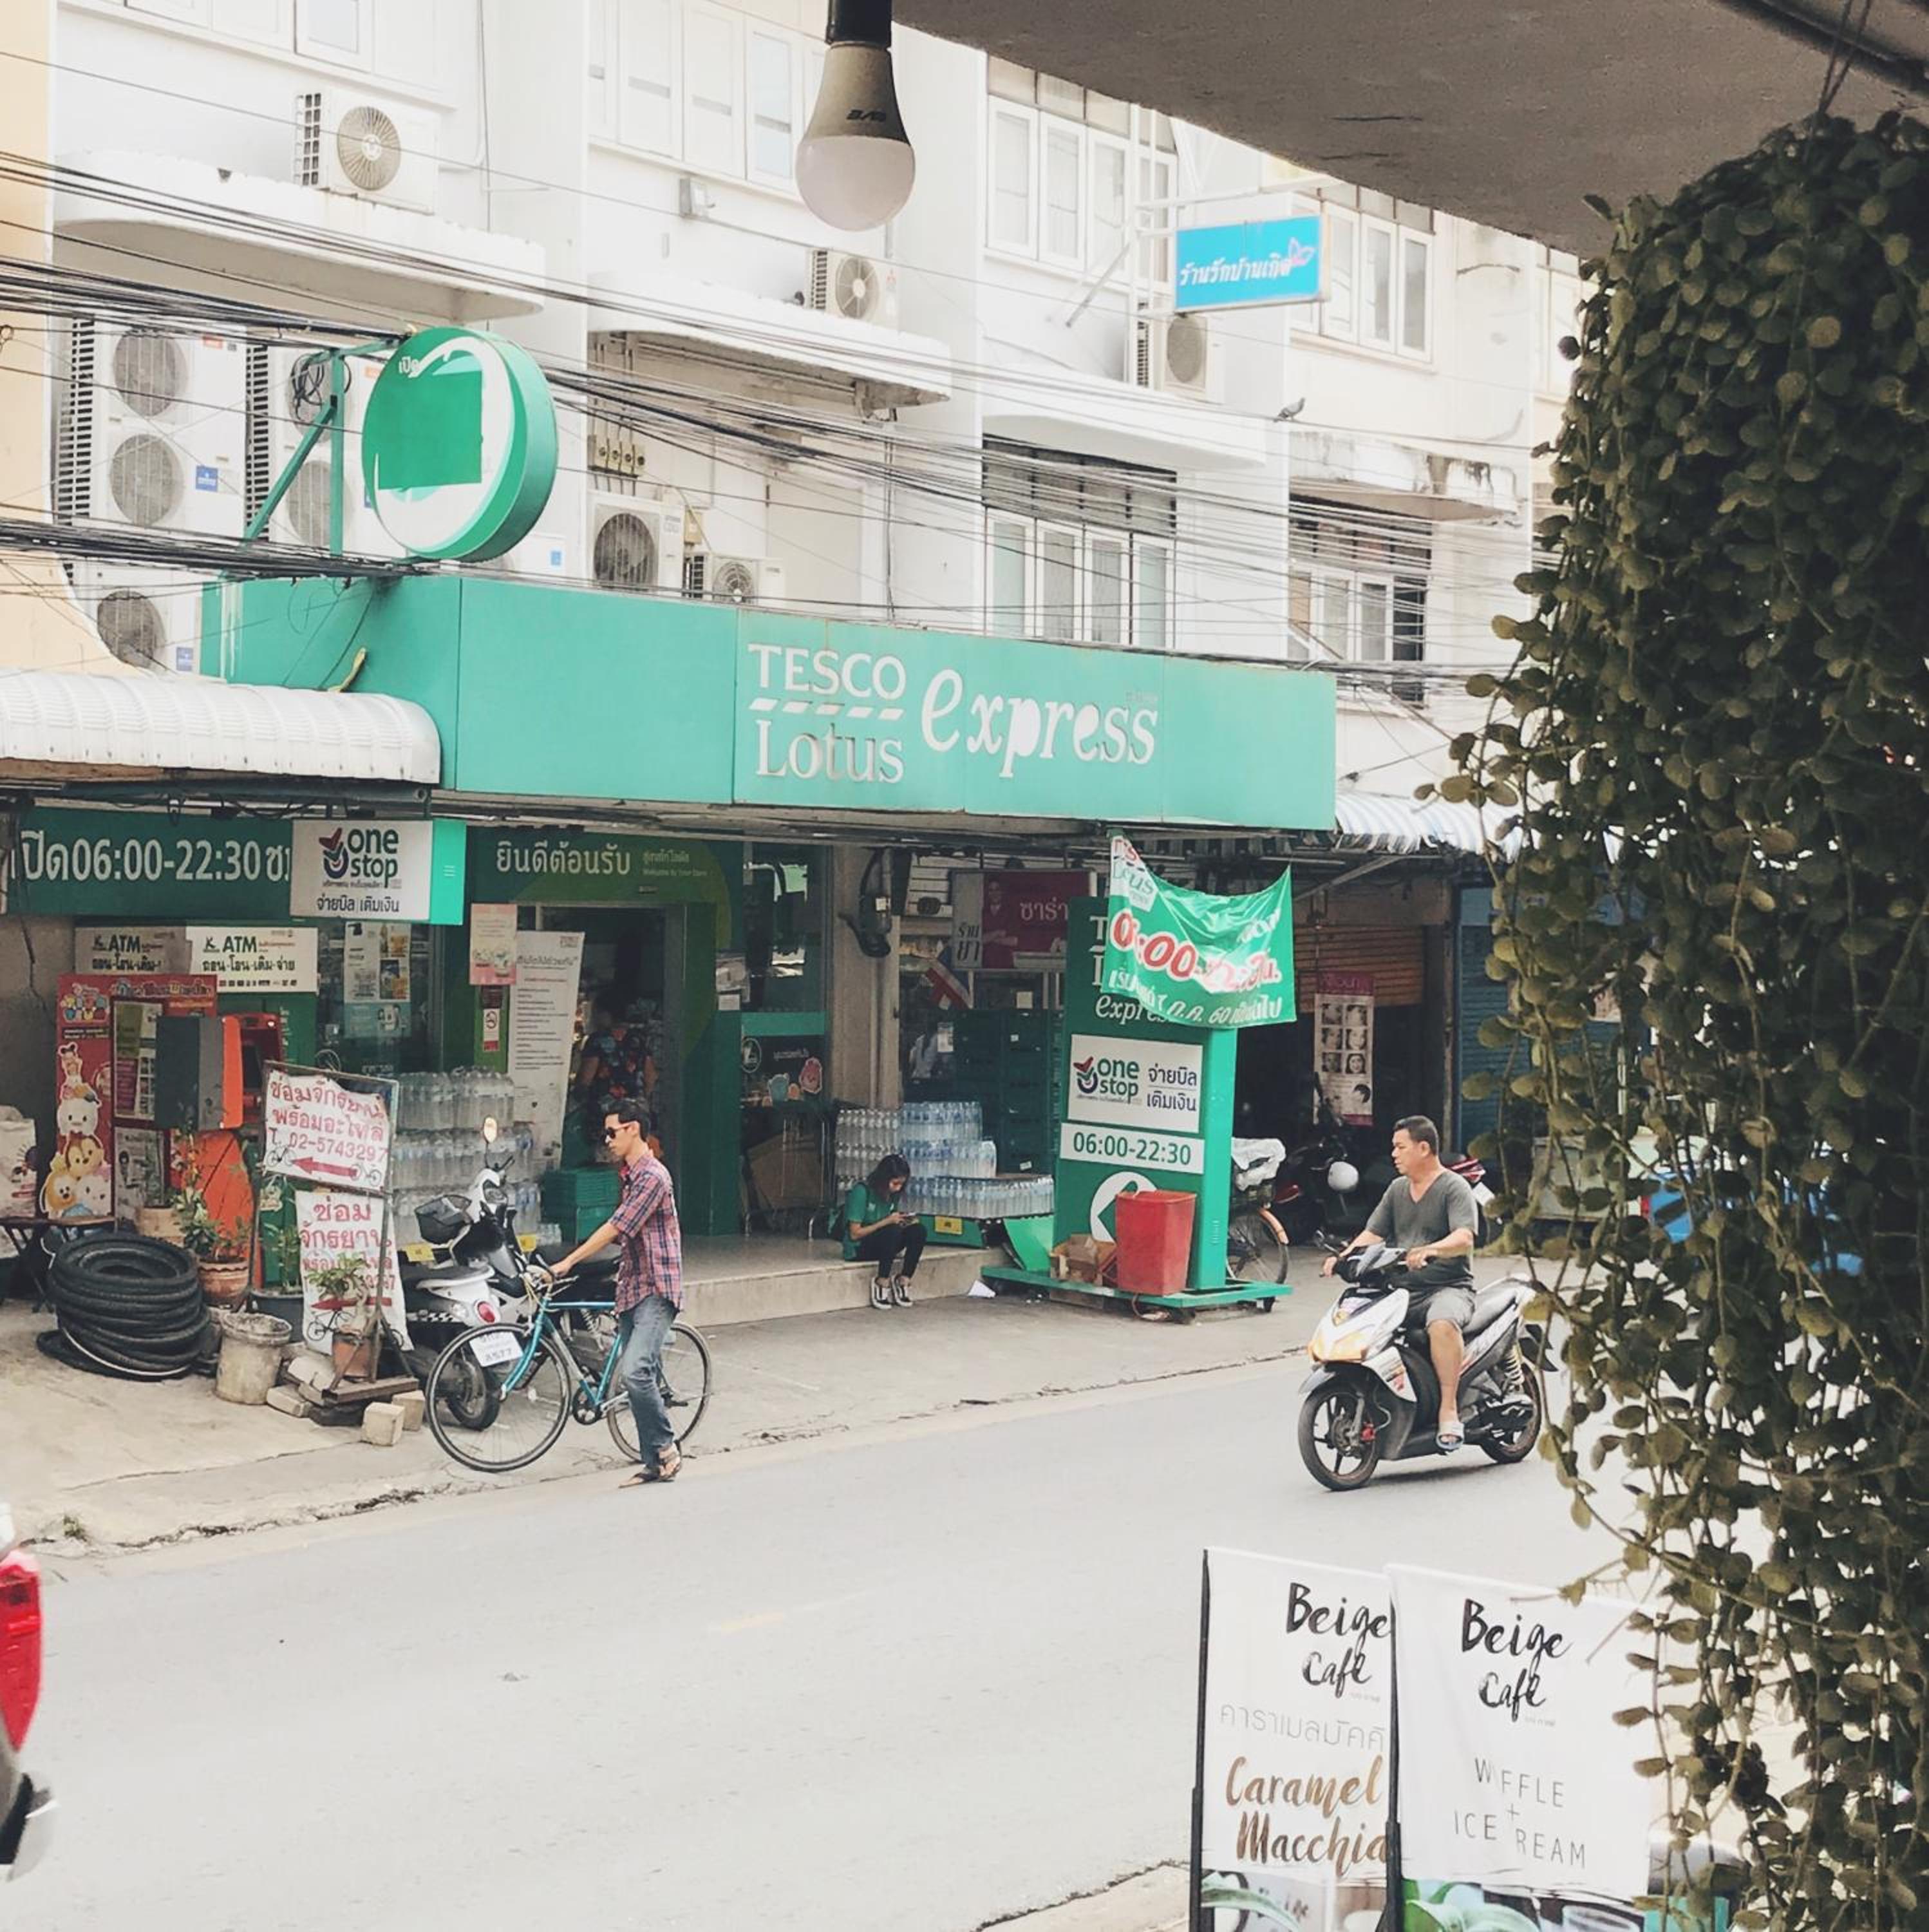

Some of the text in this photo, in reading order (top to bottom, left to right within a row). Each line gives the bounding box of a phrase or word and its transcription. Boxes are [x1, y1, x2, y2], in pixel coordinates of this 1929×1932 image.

[748, 643, 907, 700] TESCO
[921, 668, 1158, 778] express
[755, 719, 904, 784] Lotus
[347, 828, 399, 855] one
[496, 840, 631, 876] ยินดีต้อนรับ
[350, 855, 399, 889] stop
[317, 894, 400, 913] จ่ายบิล เติมเงิน
[108, 934, 141, 953] ATM
[221, 936, 258, 953] ATM
[1097, 1058, 1140, 1079] one
[1147, 1063, 1198, 1086] จ่ายบิล
[1098, 1078, 1139, 1104] stop
[1146, 1090, 1197, 1112] เติมเงิน
[1073, 1132, 1192, 1166] 06:00-22:30
[1286, 1582, 1391, 1660] Beige
[1462, 1598, 1574, 1680] Beige
[1225, 1754, 1382, 1819] Caramel
[1474, 1757, 1565, 1808] WFFLE
[1453, 1809, 1498, 1841] ICE
